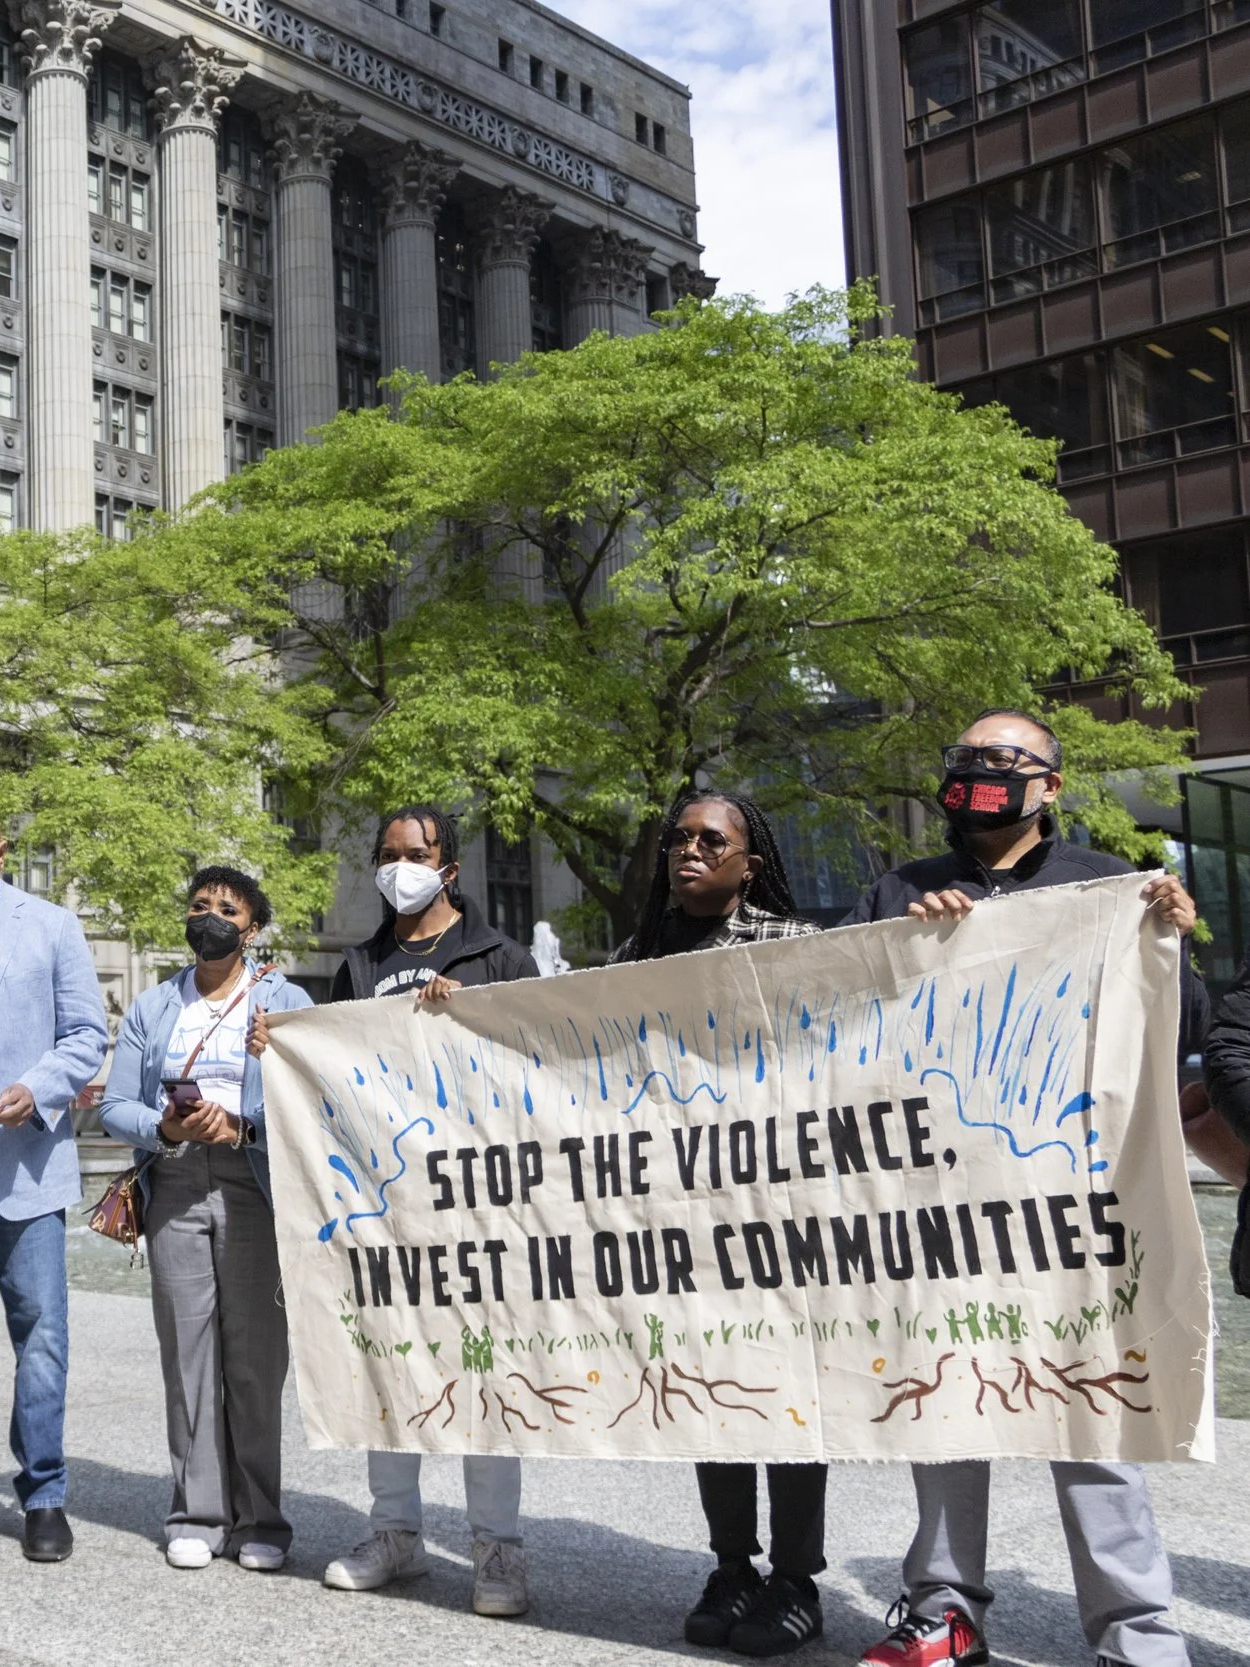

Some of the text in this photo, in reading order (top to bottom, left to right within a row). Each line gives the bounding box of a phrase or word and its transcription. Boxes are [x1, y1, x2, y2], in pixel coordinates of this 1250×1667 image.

[398, 969, 416, 985] BY
[426, 1096, 957, 1211] STOP THE VIOLENCE,
[347, 1191, 1126, 1308] INVEST IN OUR COMMUNITIES
